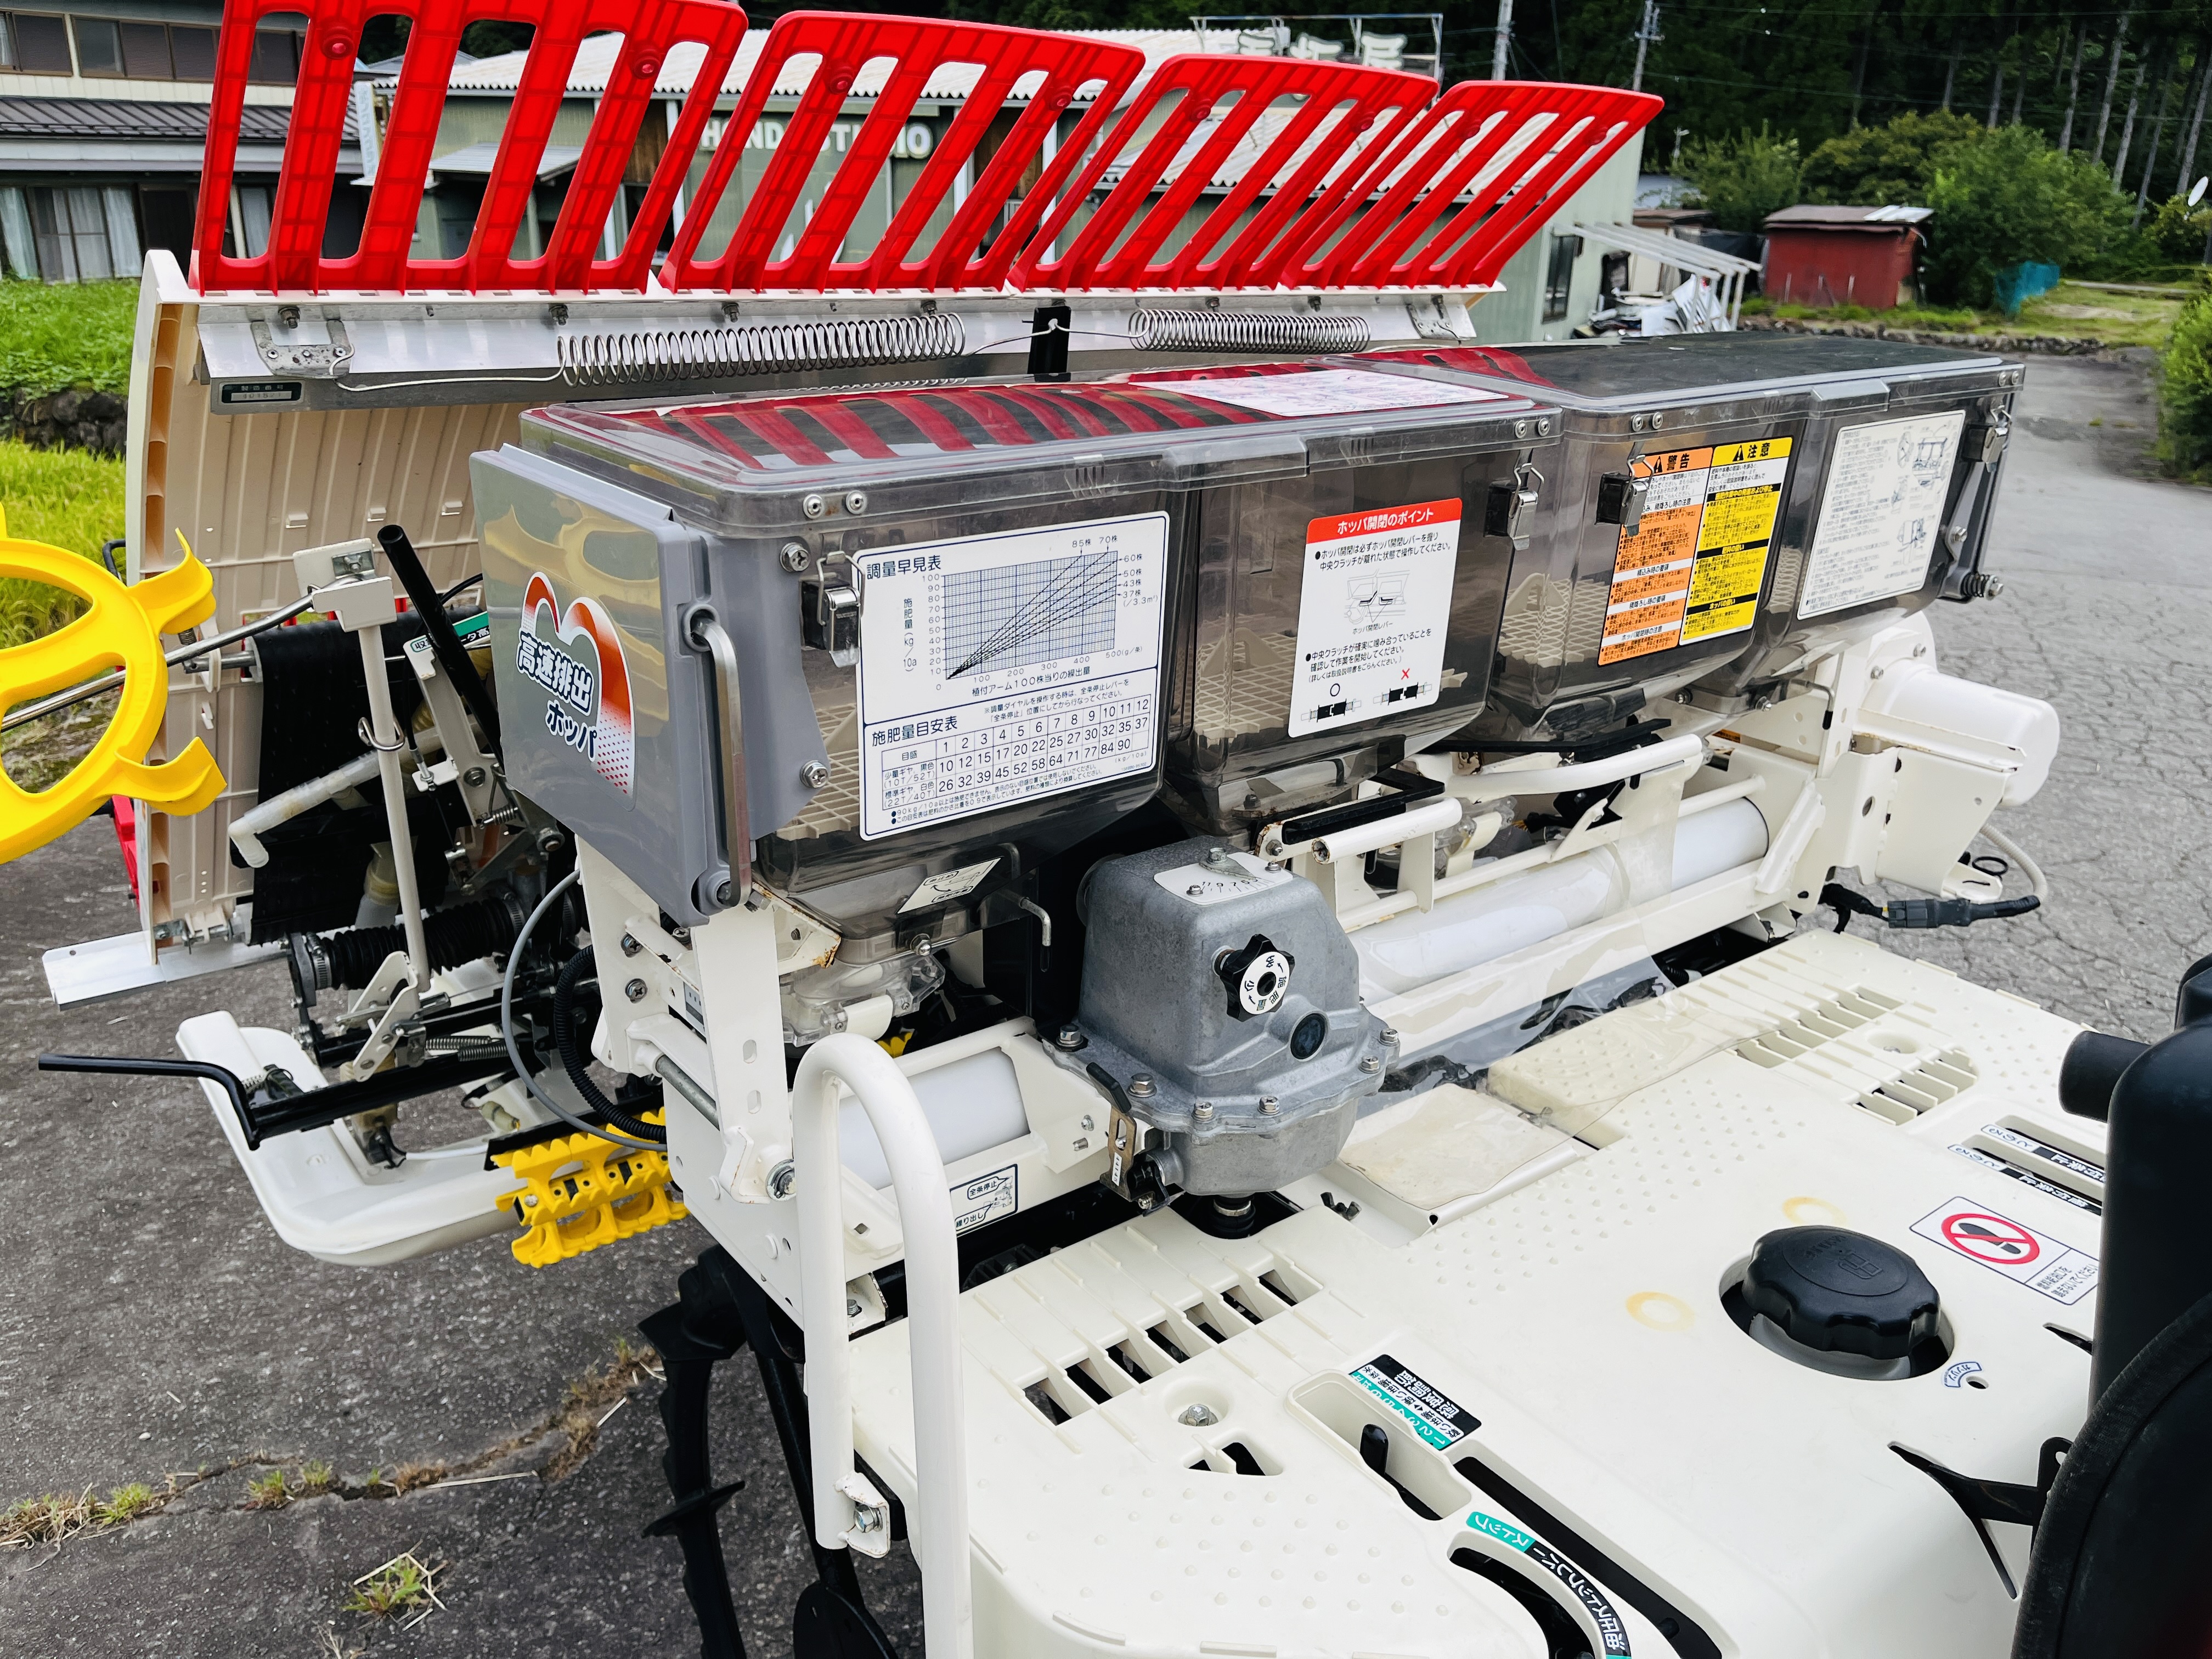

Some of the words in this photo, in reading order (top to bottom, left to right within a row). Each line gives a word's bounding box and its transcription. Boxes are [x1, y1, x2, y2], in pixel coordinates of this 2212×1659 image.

[1747, 443, 1770, 459] 注意
[1667, 453, 1690, 471] 警告
[1337, 507, 1434, 535] ホッパ開閉のポイント
[1072, 538, 1092, 548] 85株
[1099, 535, 1118, 544] 70株
[1124, 553, 1143, 563] 60株
[1319, 542, 1451, 572] 中央クラッチが離れた状態で操作してください。
[866, 555, 941, 580] 調量早見表
[1123, 568, 1142, 578] 50株
[922, 573, 940, 583] 100
[1123, 579, 1142, 588] 43株
[928, 584, 940, 592] 90
[1122, 589, 1141, 599] 37株
[928, 595, 940, 603] 80
[928, 605, 940, 613] 70
[928, 616, 940, 624] 60
[1352, 621, 1393, 635] ホッパ開閉レバー
[929, 647, 941, 655] 30
[1311, 628, 1432, 661] 中央クラッチが確実に噛み合っていることを
[929, 657, 941, 665] 20
[1310, 646, 1404, 673] 確認して作業を開始してください。
[519, 631, 593, 714] 高速排出
[974, 674, 990, 684] 100
[1007, 668, 1024, 677] 200
[1041, 662, 1058, 670] 300
[1073, 656, 1090, 664] 400
[972, 665, 1091, 697] 植付アーム100株当りの繰出量
[547, 702, 597, 759] ホッパ
[872, 715, 958, 747] 施肥量目安表
[943, 742, 948, 753] 1
[962, 737, 969, 748] 2
[980, 733, 988, 744] 3
[999, 729, 1006, 740] 4
[1018, 725, 1024, 737] 5
[1036, 721, 1042, 732] 6
[1053, 718, 1060, 729] 7
[1071, 714, 1077, 725] 8
[1088, 710, 1095, 721] 9
[1103, 706, 1116, 718] 10
[1120, 702, 1131, 715] 11
[1137, 698, 1149, 711] 12
[940, 760, 953, 773] 10
[959, 755, 972, 769] 12
[978, 752, 991, 764] 15
[996, 747, 1009, 760] 17
[1013, 743, 1028, 756] 20
[1031, 740, 1046, 752] 22
[1049, 736, 1063, 748] 25
[1067, 732, 1081, 744] 27
[1085, 728, 1098, 741] 30
[1101, 724, 1115, 736] 32
[1118, 720, 1132, 733] 35
[1135, 717, 1148, 730] 37
[938, 779, 953, 792] 26
[958, 775, 972, 788] 32
[977, 770, 991, 783] 39
[995, 766, 1009, 779] 45
[1013, 762, 1028, 775] 52
[1031, 758, 1046, 770] 58
[1049, 754, 1063, 766] 64
[1067, 750, 1079, 763] 71
[1084, 746, 1097, 759] 77
[1101, 742, 1114, 754] 84
[1118, 738, 1131, 751] 90
[1244, 980, 1255, 991] 少
[969, 1180, 997, 1197] 全条停止
[1948, 1364, 1972, 1381] ガソリン
[1393, 1370, 1460, 1420] 感度調節
[1419, 1426, 1433, 1436] 2
[1434, 1436, 1446, 1446] 1
[1475, 1514, 1529, 1547] ストップ
[1533, 1547, 1626, 1651] 油圧ストップレバー
